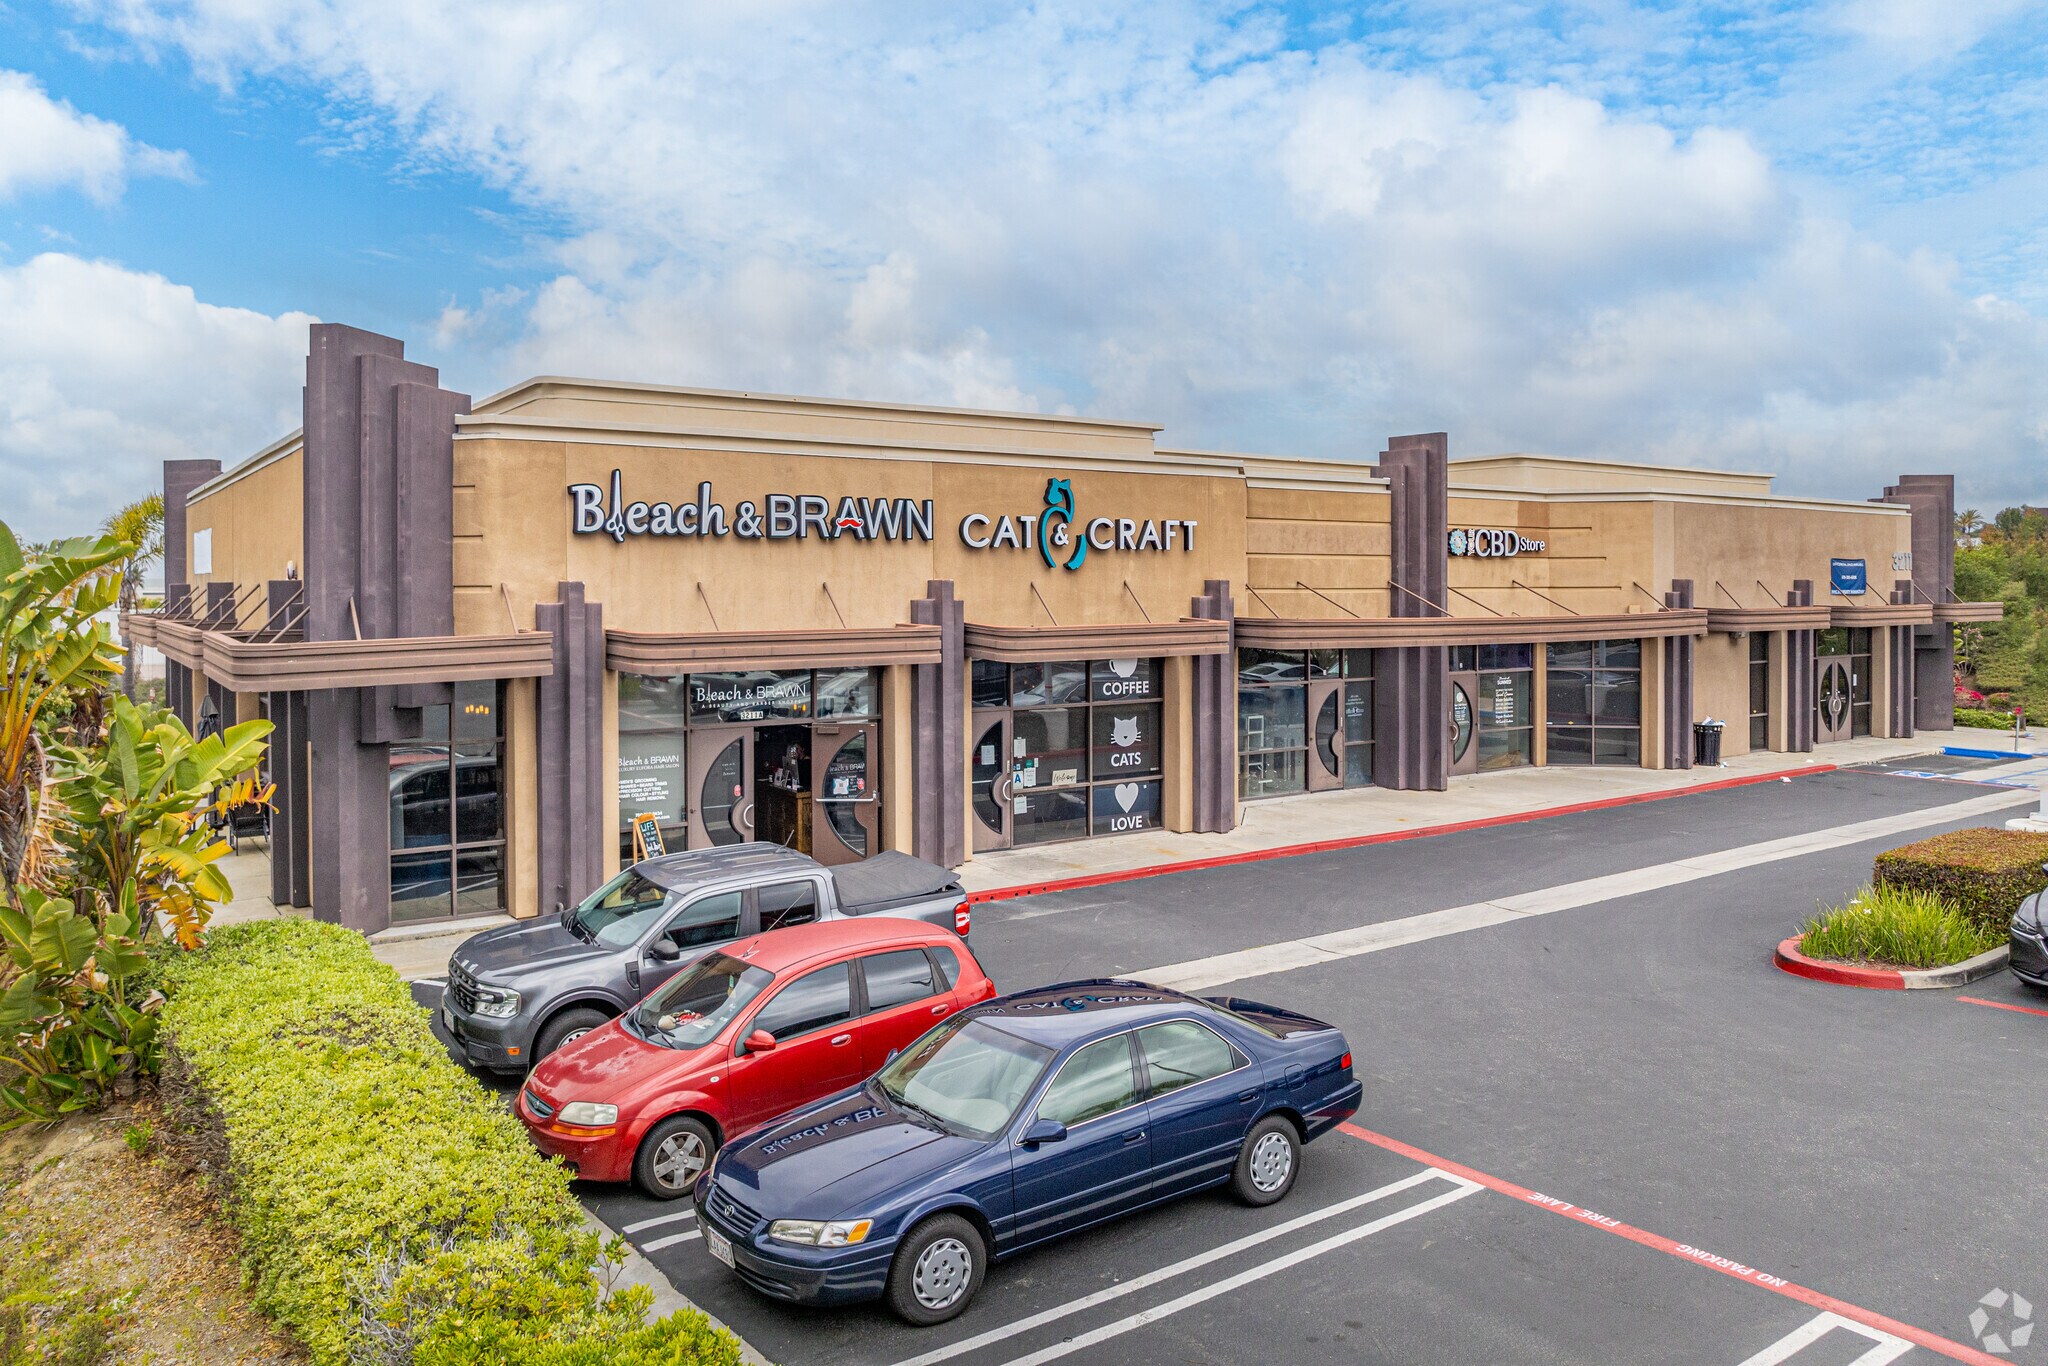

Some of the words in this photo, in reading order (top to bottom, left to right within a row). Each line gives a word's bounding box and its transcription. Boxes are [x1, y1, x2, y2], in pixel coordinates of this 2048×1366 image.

[568, 468, 729, 543] Bleach
[733, 500, 764, 539] &
[765, 493, 934, 541] BRAWN
[959, 513, 1037, 549] CAT
[1051, 523, 1069, 546] &
[1086, 517, 1198, 551] CRAFT
[1475, 529, 1520, 557] CBD
[1520, 537, 1545, 551] Store
[1892, 553, 1913, 571] 3211
[696, 682, 741, 703] Bleach
[745, 688, 753, 699] &
[756, 683, 806, 699] BRAWN
[1103, 681, 1149, 696] COFFEE
[619, 755, 643, 767] Bleach
[650, 755, 679, 764] BRAWN
[1111, 752, 1142, 767] CATS
[1015, 774, 1021, 783] A
[640, 821, 655, 832] LIFE
[1111, 815, 1142, 831] LOVE
[1527, 1192, 1574, 1211] LANE
[1576, 1209, 1621, 1227] FIRE
[1675, 1244, 1756, 1275] PARKING
[1756, 1273, 1788, 1287] NO
